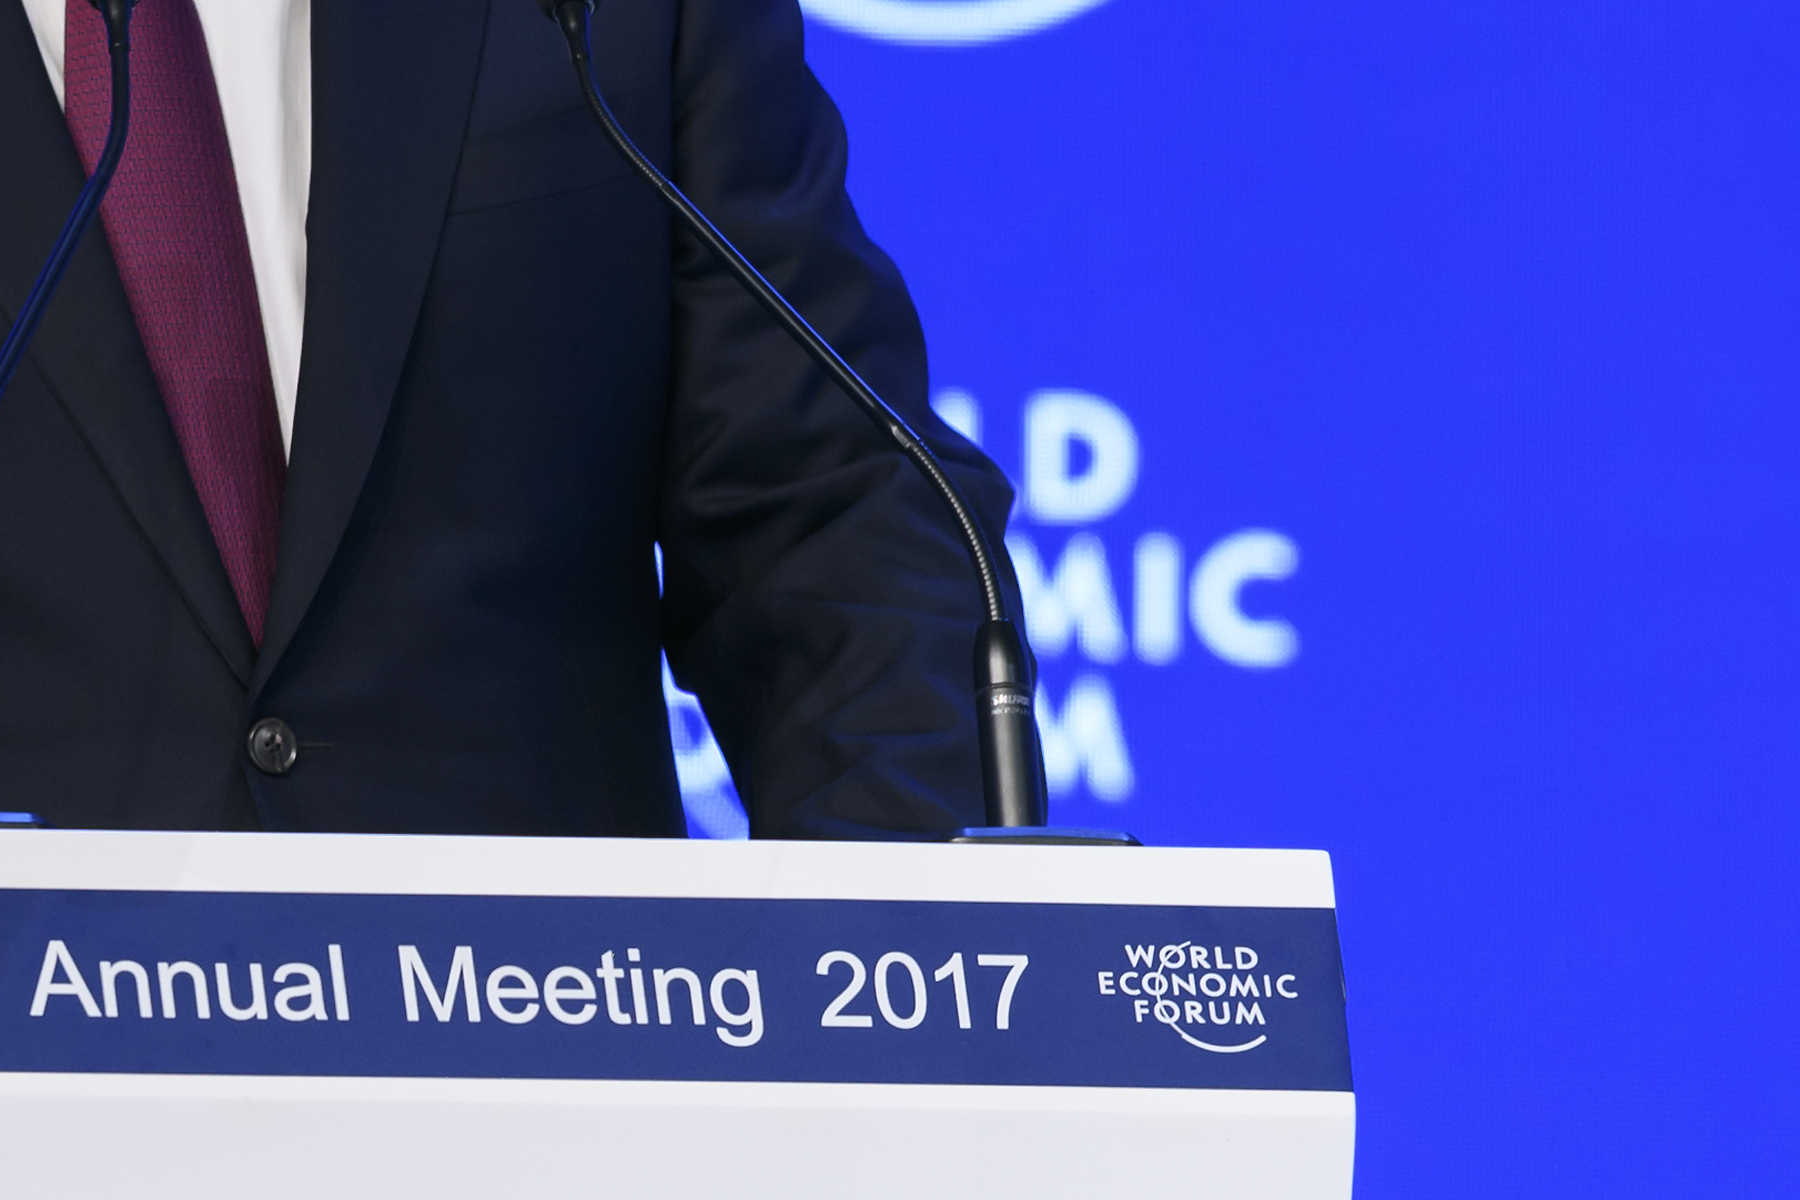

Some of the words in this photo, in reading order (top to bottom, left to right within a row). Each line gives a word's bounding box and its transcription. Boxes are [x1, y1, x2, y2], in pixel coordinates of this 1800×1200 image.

[1124, 944, 1259, 970] WORLD
[29, 939, 350, 1021] Annual
[398, 945, 764, 1048] Meeting
[814, 950, 1029, 1031] 2017
[1098, 971, 1298, 998] ECONOMIC
[1134, 999, 1266, 1026] FORUM
